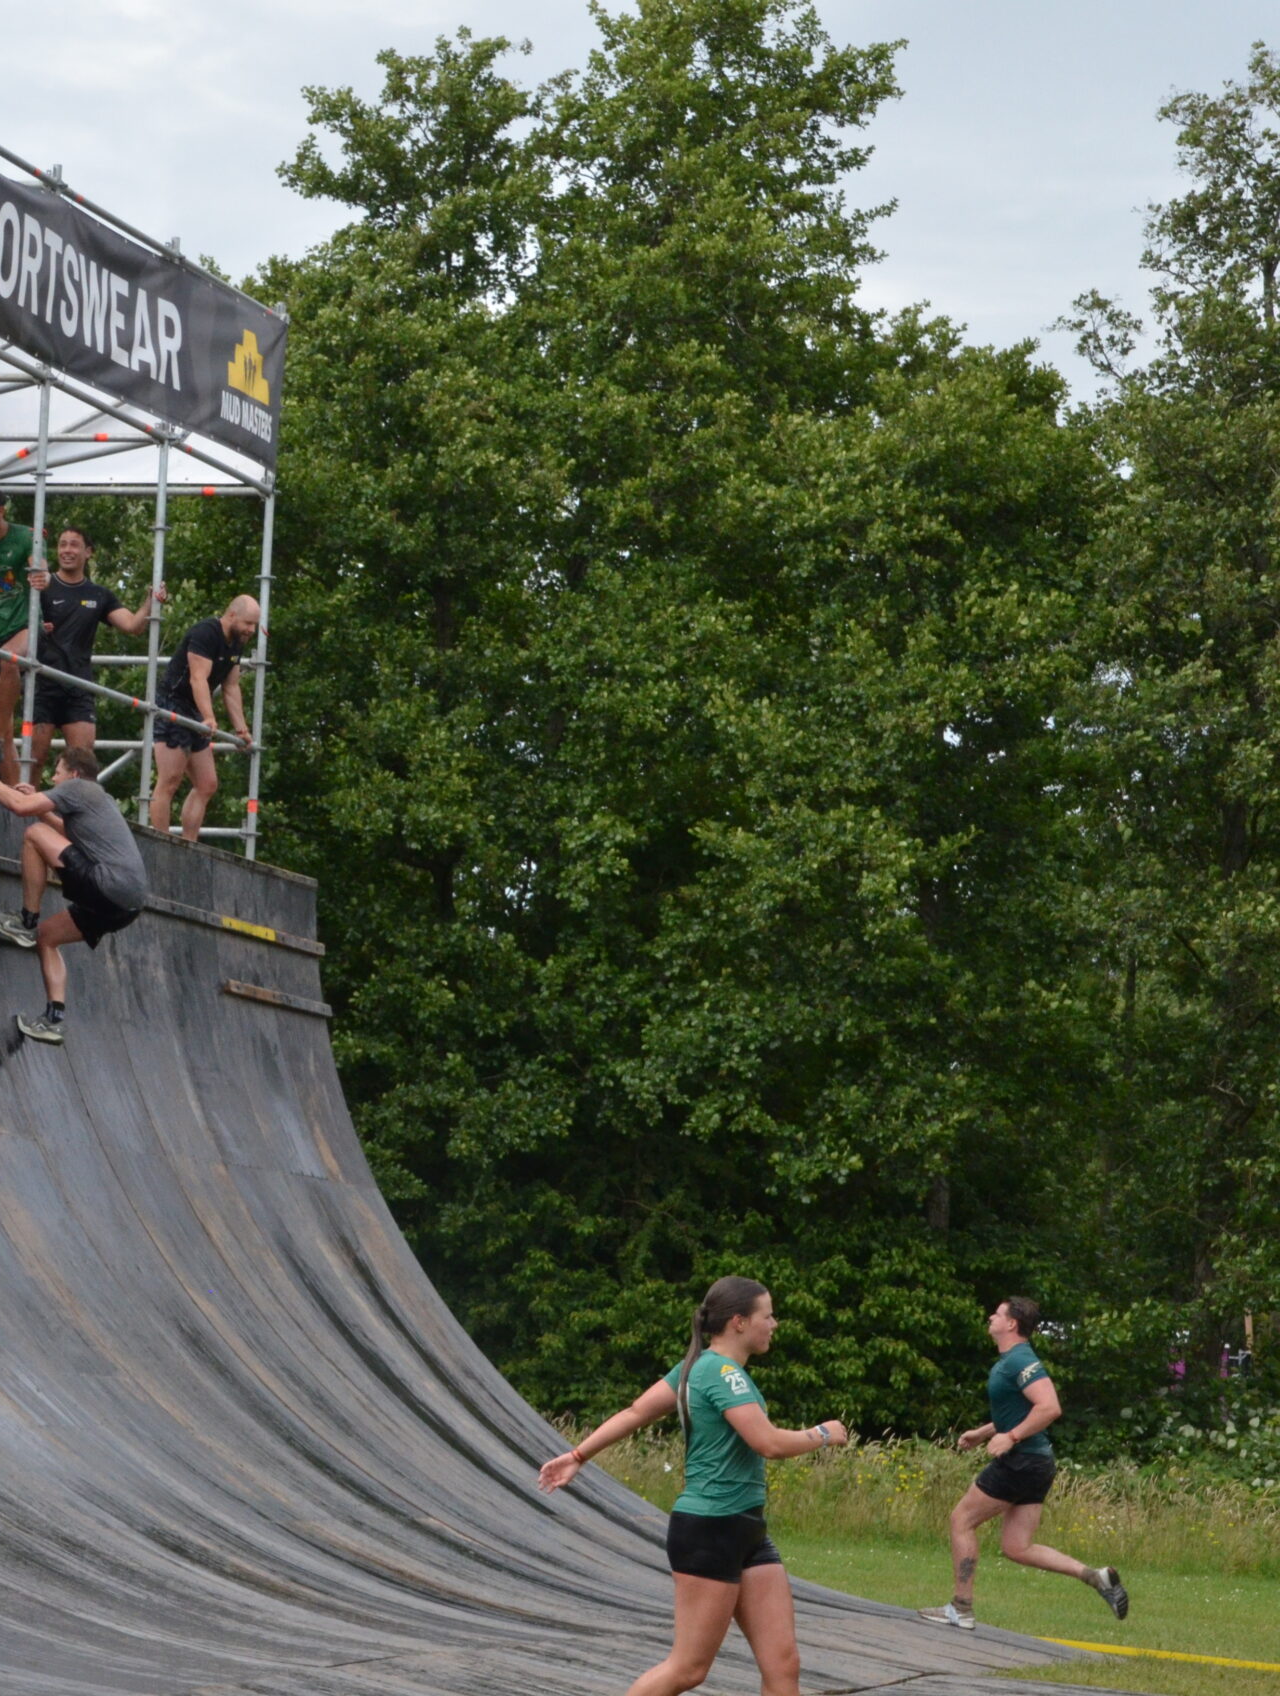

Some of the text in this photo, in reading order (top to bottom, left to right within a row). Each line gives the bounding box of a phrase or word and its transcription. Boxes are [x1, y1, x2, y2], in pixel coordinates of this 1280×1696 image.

[220, 390, 273, 444] MUD MASTERS
[724, 1373, 747, 1391] 25
